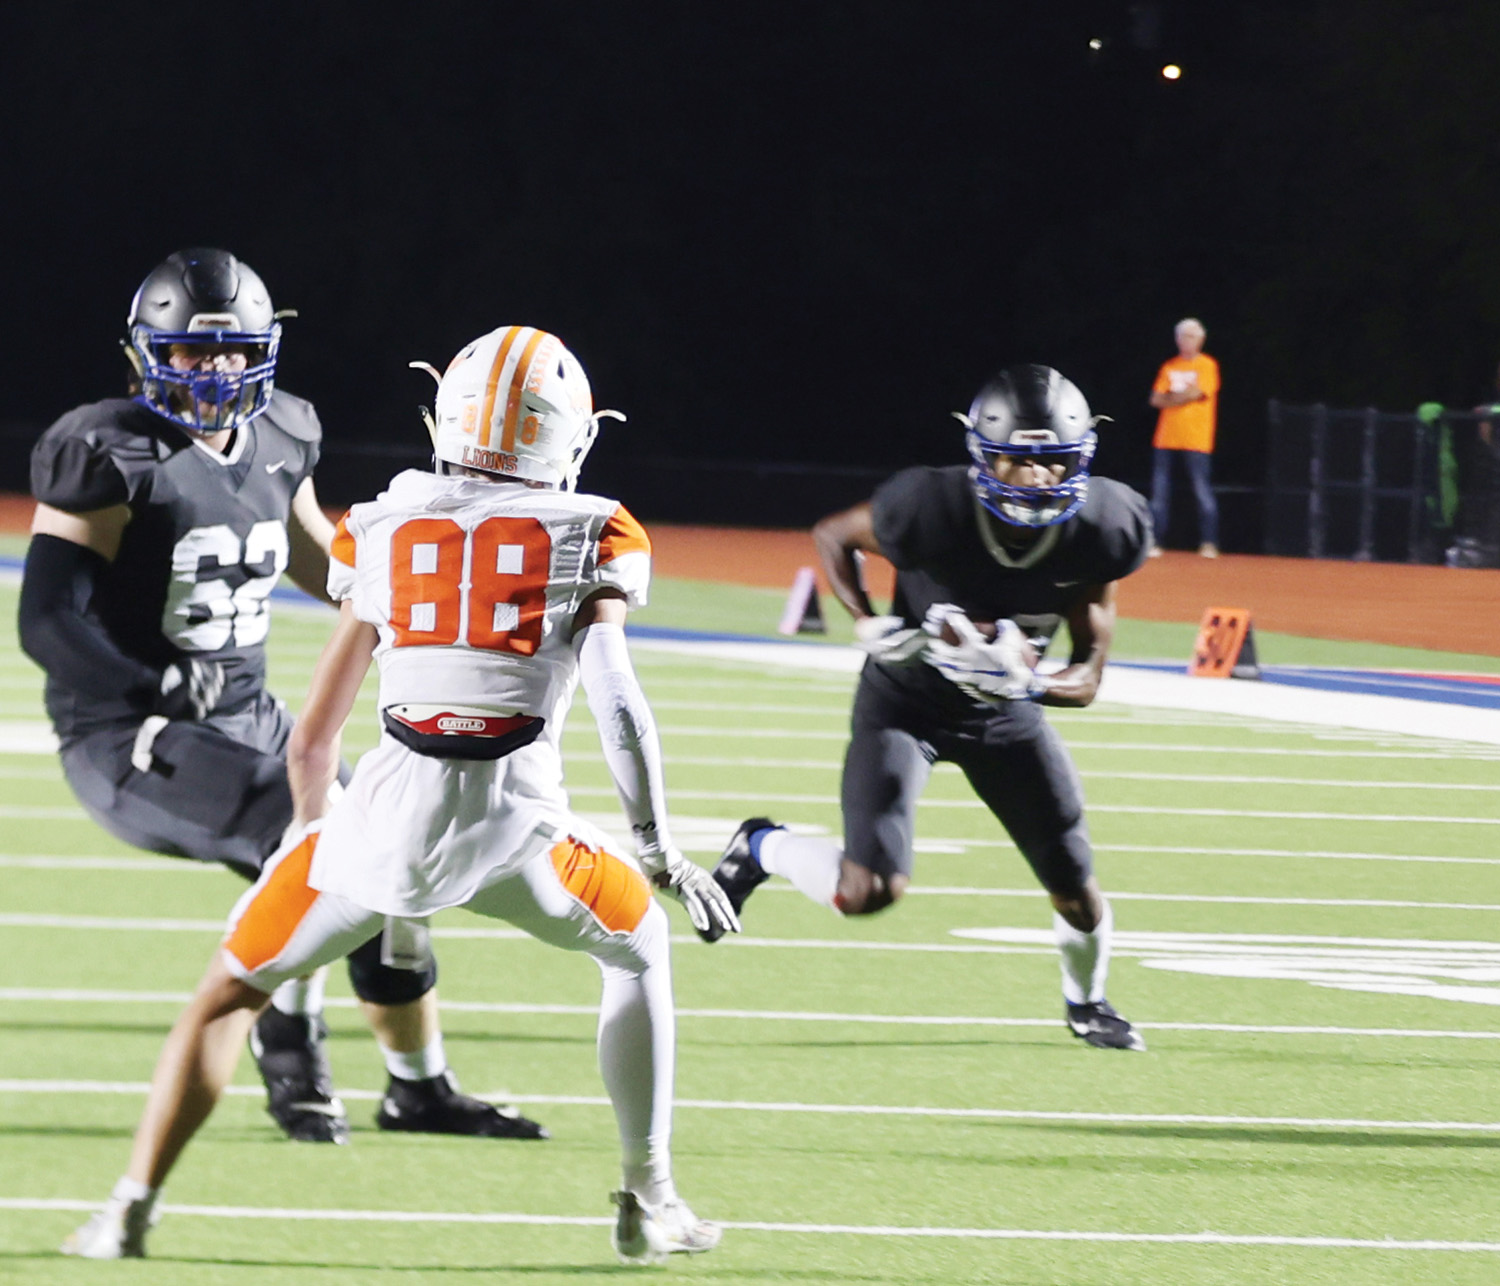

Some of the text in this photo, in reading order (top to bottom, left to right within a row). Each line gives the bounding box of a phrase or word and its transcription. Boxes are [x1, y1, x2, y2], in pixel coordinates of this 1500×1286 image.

[462, 445, 518, 475] LIONS
[161, 519, 290, 652] 62
[388, 516, 552, 657] 88
[441, 718, 483, 730] BATTLE
